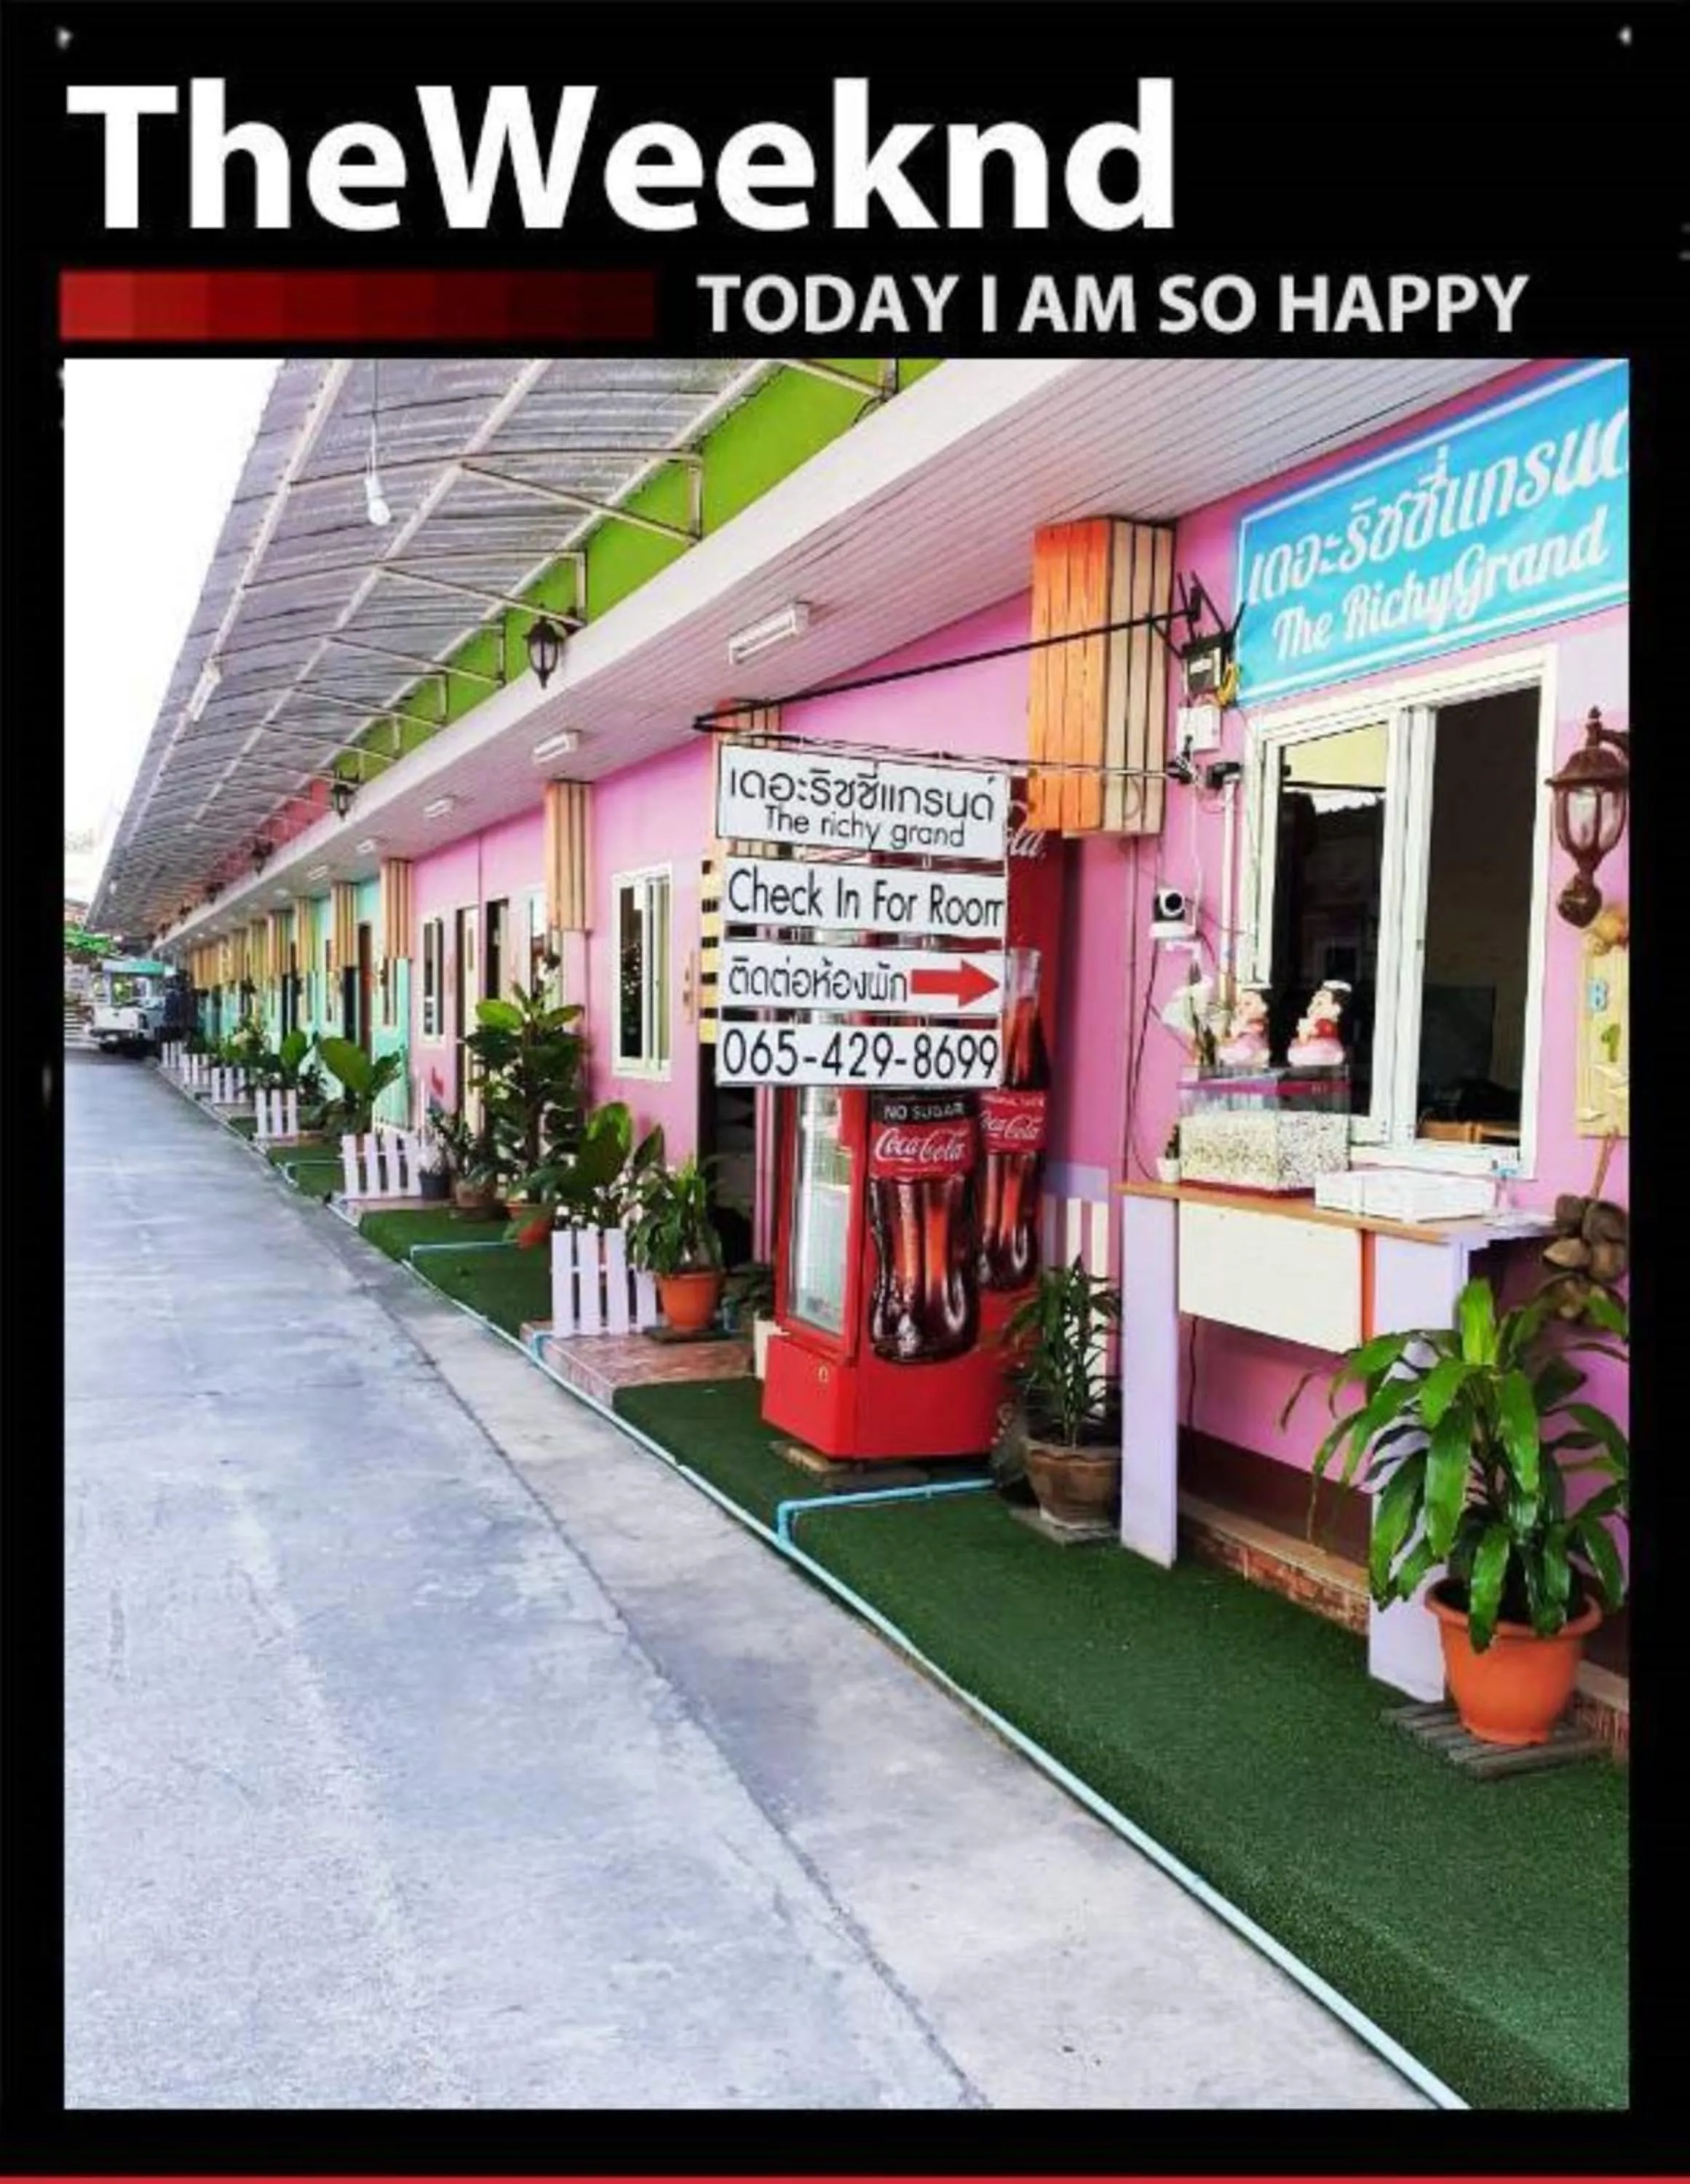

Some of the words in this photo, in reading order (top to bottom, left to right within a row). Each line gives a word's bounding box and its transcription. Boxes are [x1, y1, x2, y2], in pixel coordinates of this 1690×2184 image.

[1272, 604, 1333, 661] The
[764, 804, 810, 834] The
[820, 810, 880, 850] richy
[890, 821, 966, 850] grand
[728, 866, 823, 918] Check
[836, 877, 860, 919] In
[873, 879, 919, 922] For
[729, 955, 908, 1003] ติดต่อห้องพัก
[722, 1028, 999, 1080] 065-429-8699
[884, 1104, 908, 1120] NO
[912, 1102, 964, 1120] SUGAR
